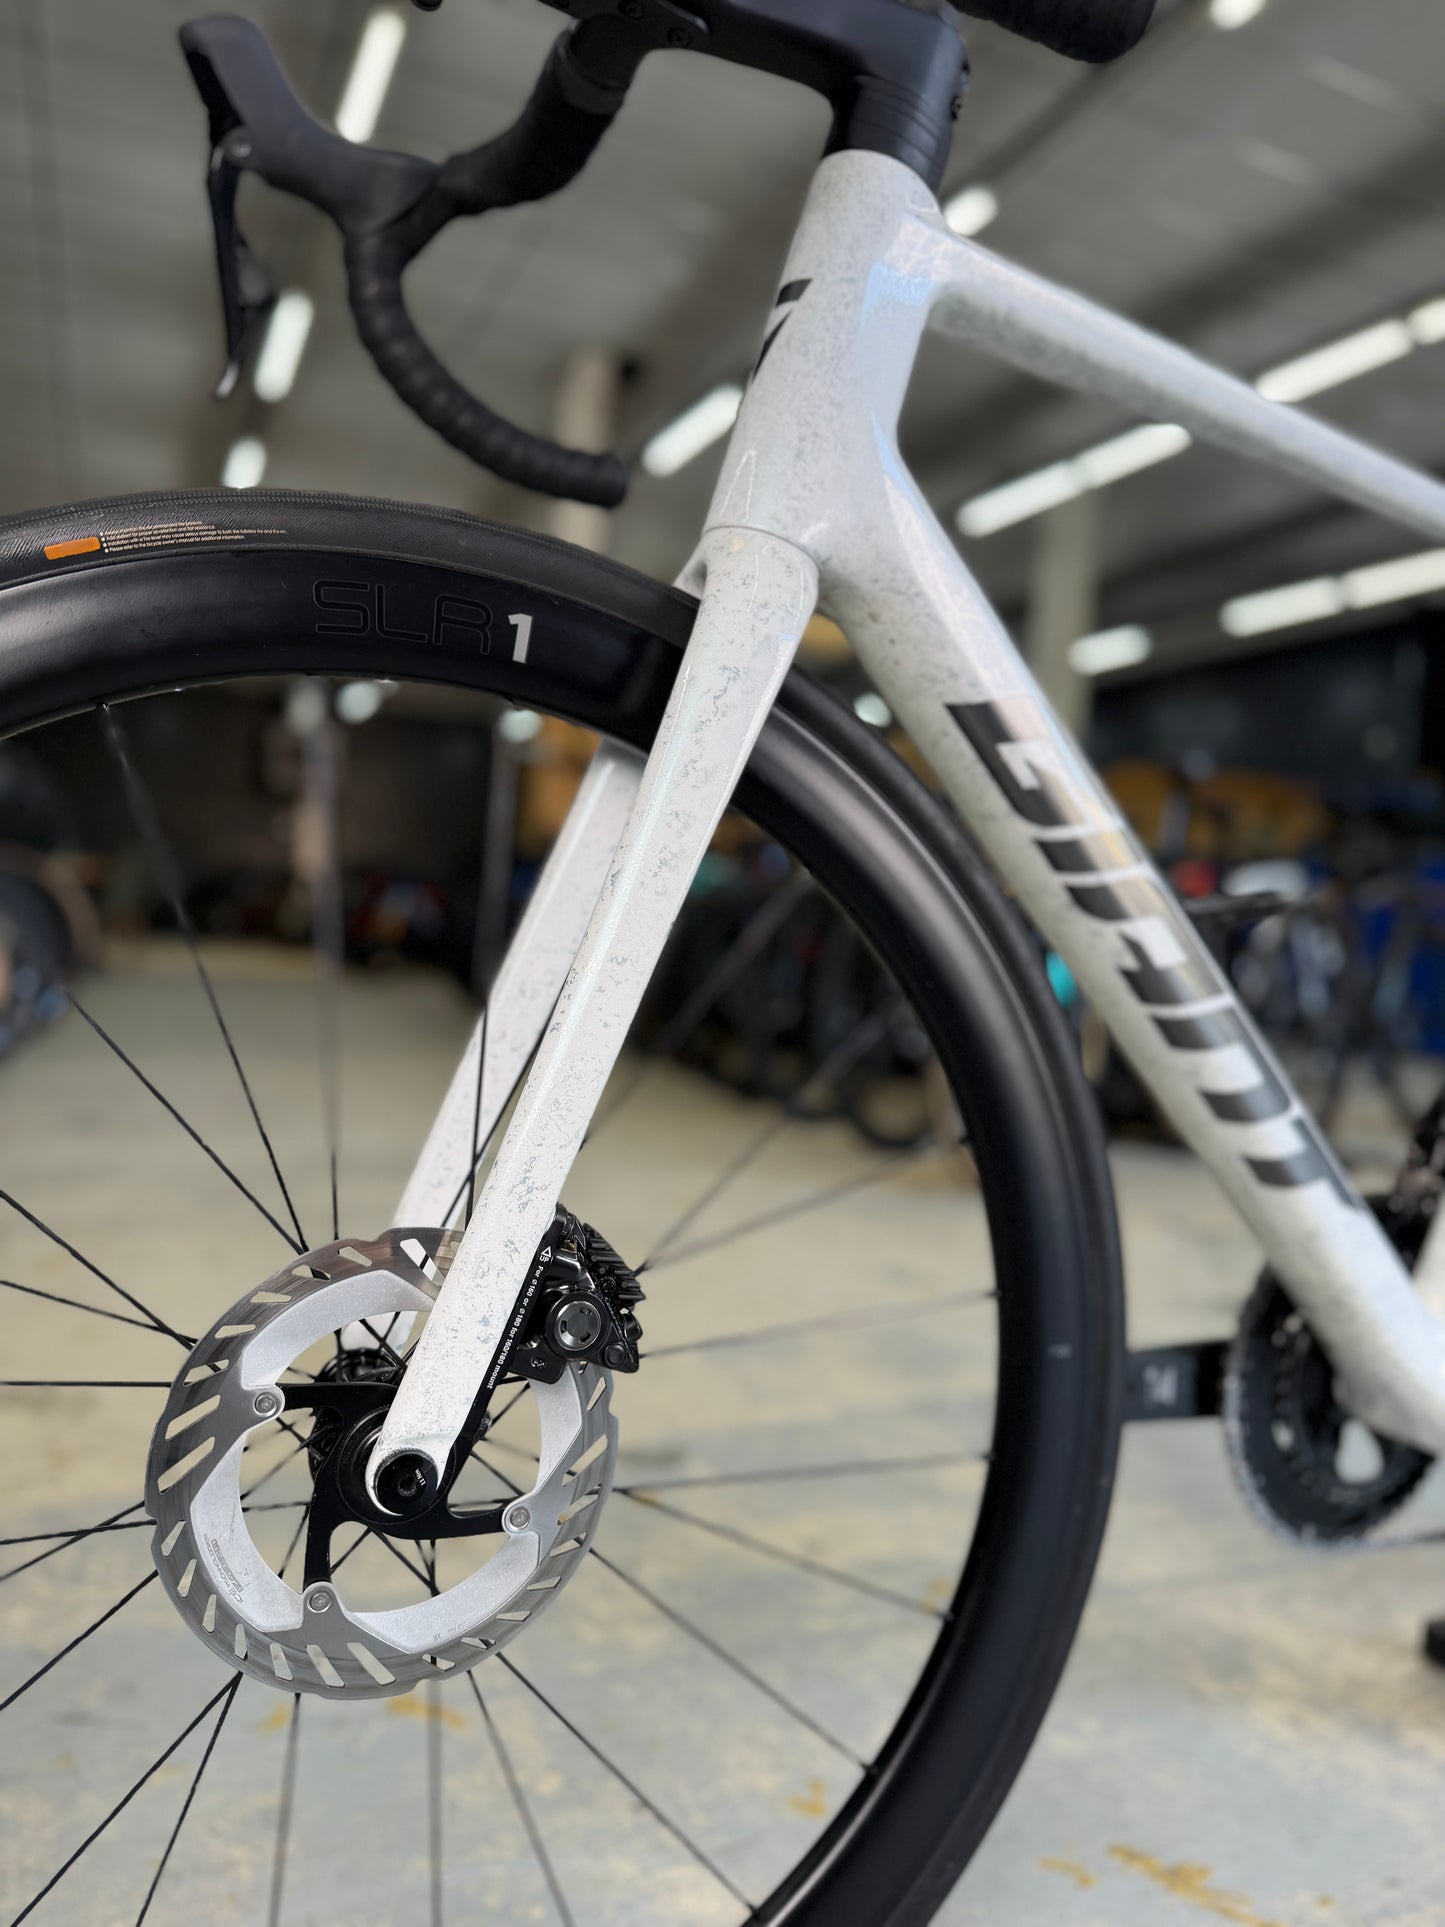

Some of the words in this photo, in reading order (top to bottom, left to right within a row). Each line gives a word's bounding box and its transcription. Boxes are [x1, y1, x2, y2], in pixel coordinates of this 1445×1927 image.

[313, 579, 493, 655] SLR
[508, 613, 533, 664] 1
[946, 702, 1360, 1207] GIANT
[534, 1266, 544, 1277] For
[523, 1298, 529, 1306] or
[509, 1327, 518, 1338] for
[487, 1366, 500, 1389] mount
